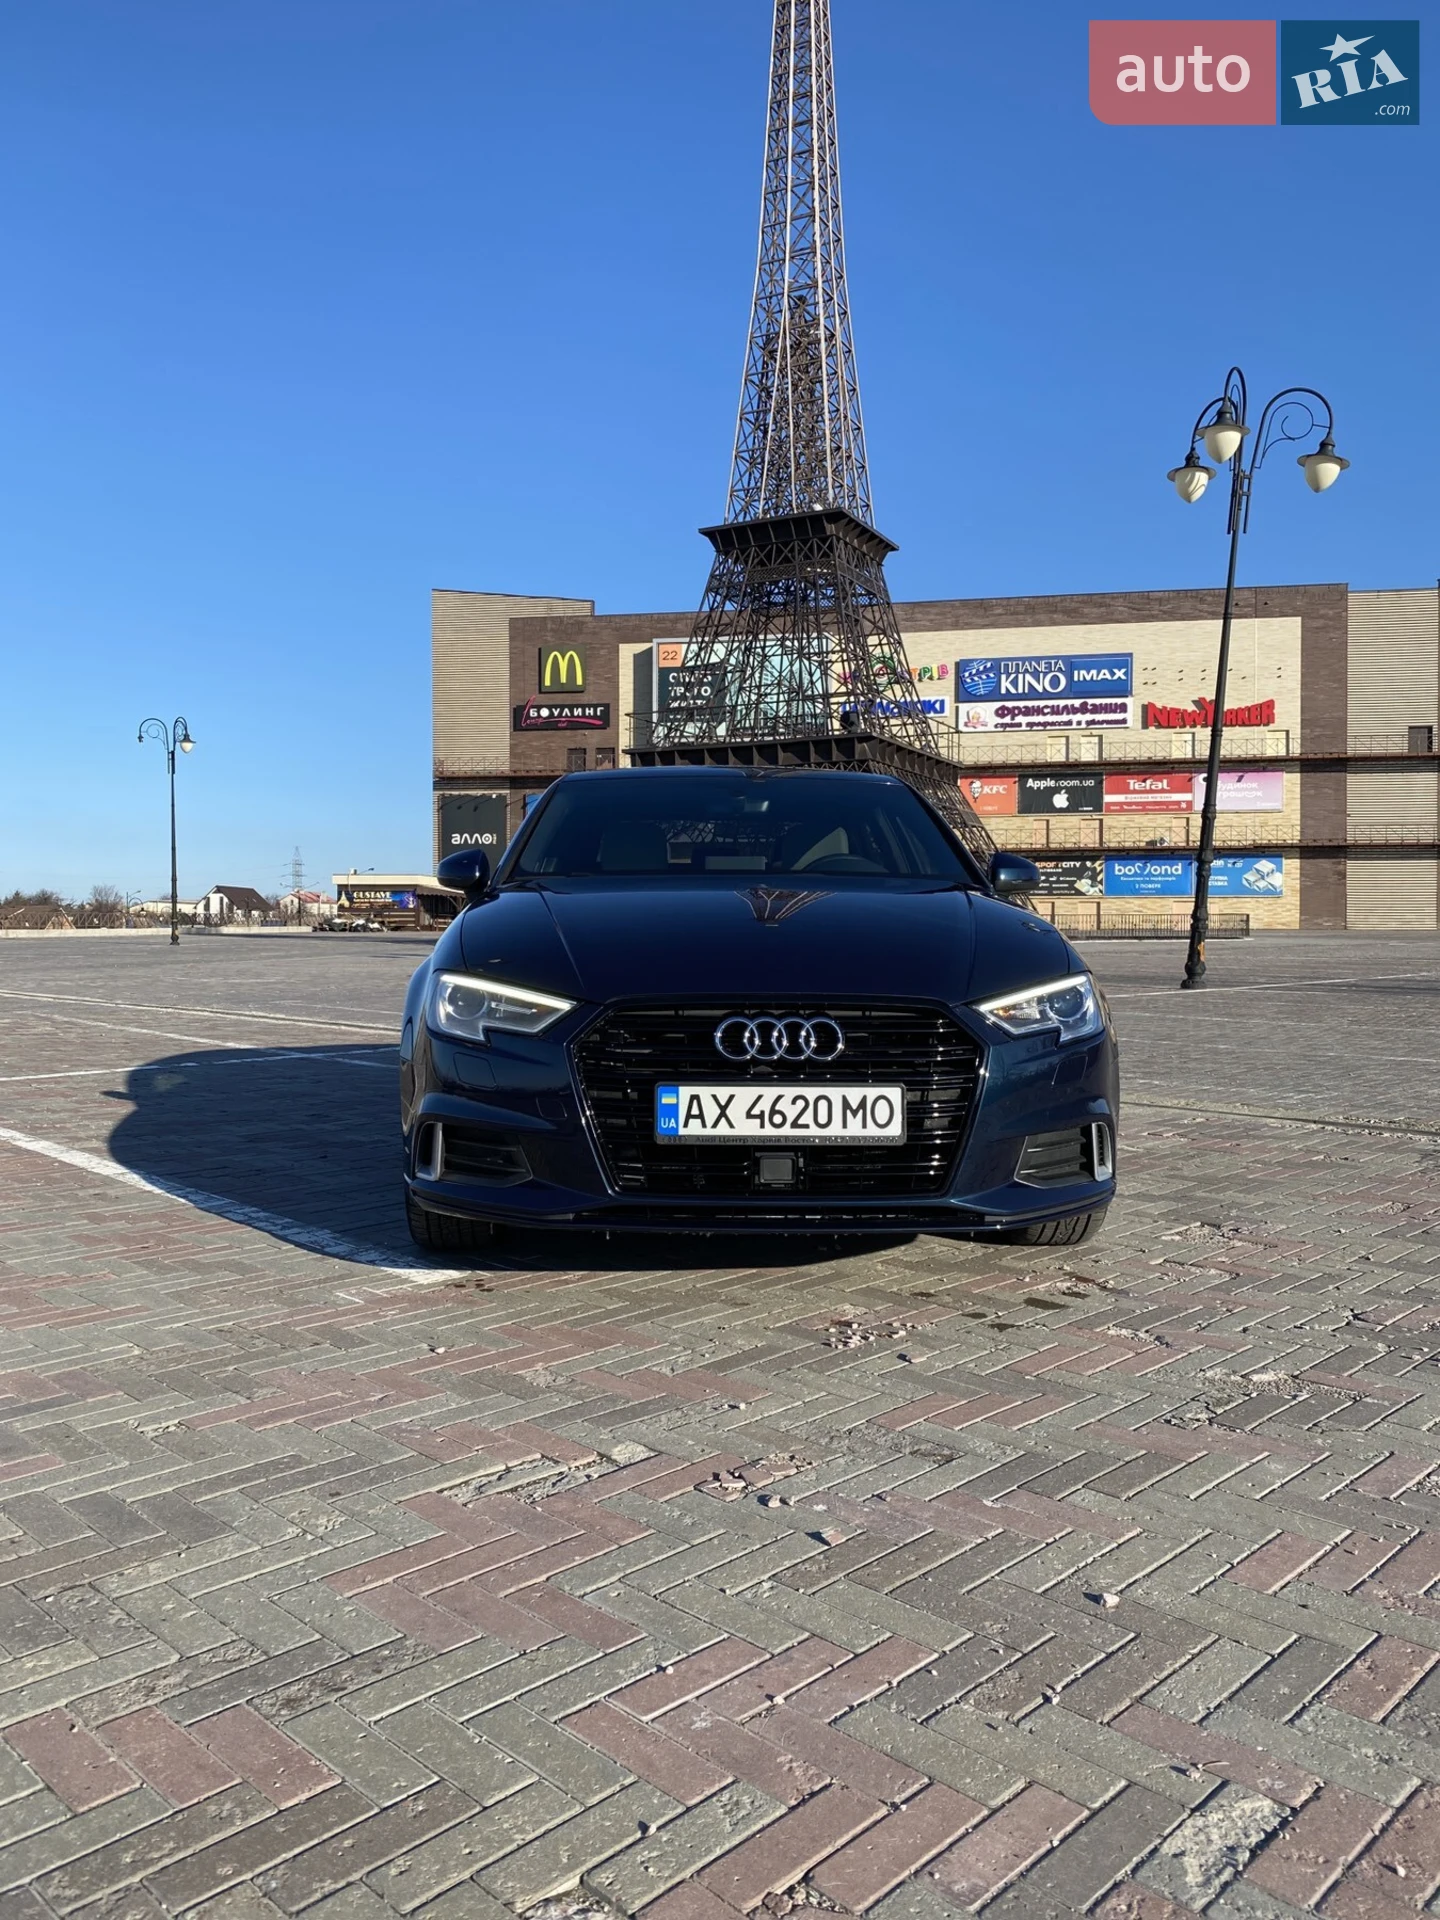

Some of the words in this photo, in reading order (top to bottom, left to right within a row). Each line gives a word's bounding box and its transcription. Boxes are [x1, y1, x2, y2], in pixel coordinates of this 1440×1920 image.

[662, 651, 678, 660] 22
[1073, 668, 1127, 681] IMAX
[1000, 672, 1067, 694] KINO
[529, 707, 604, 717] БОУЛИНГ
[982, 785, 1008, 794] KFC
[1126, 779, 1171, 791] Tefal
[683, 1094, 736, 1129] AX
[745, 1094, 833, 1129] 4620
[842, 1094, 895, 1129] MO
[661, 1118, 677, 1128] UA
